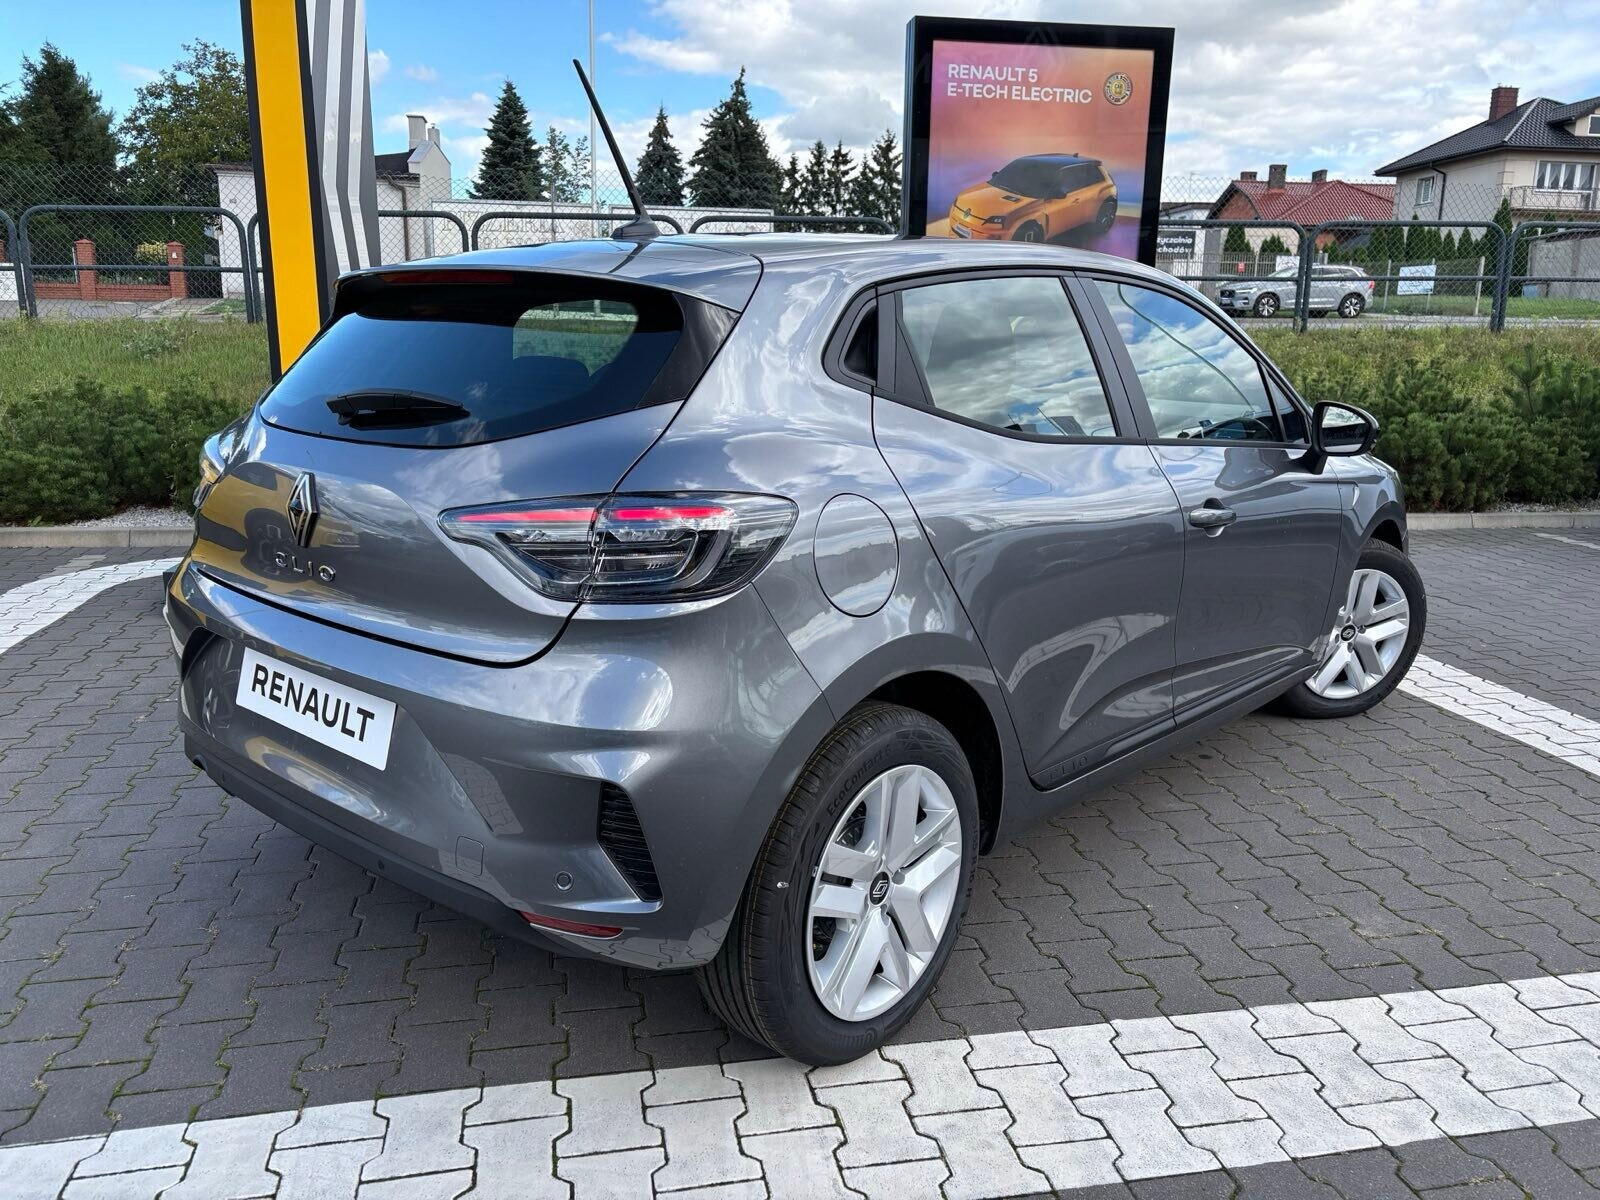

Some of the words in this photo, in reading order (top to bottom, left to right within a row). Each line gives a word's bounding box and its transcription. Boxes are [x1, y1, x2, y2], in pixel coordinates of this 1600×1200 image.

[948, 64, 1026, 82] RENAULT
[1028, 68, 1038, 83] 5
[947, 82, 1008, 100] E-TECH
[1011, 85, 1093, 104] ELECTRIC
[275, 551, 337, 583] CLIO
[251, 663, 375, 743] RENAULT
